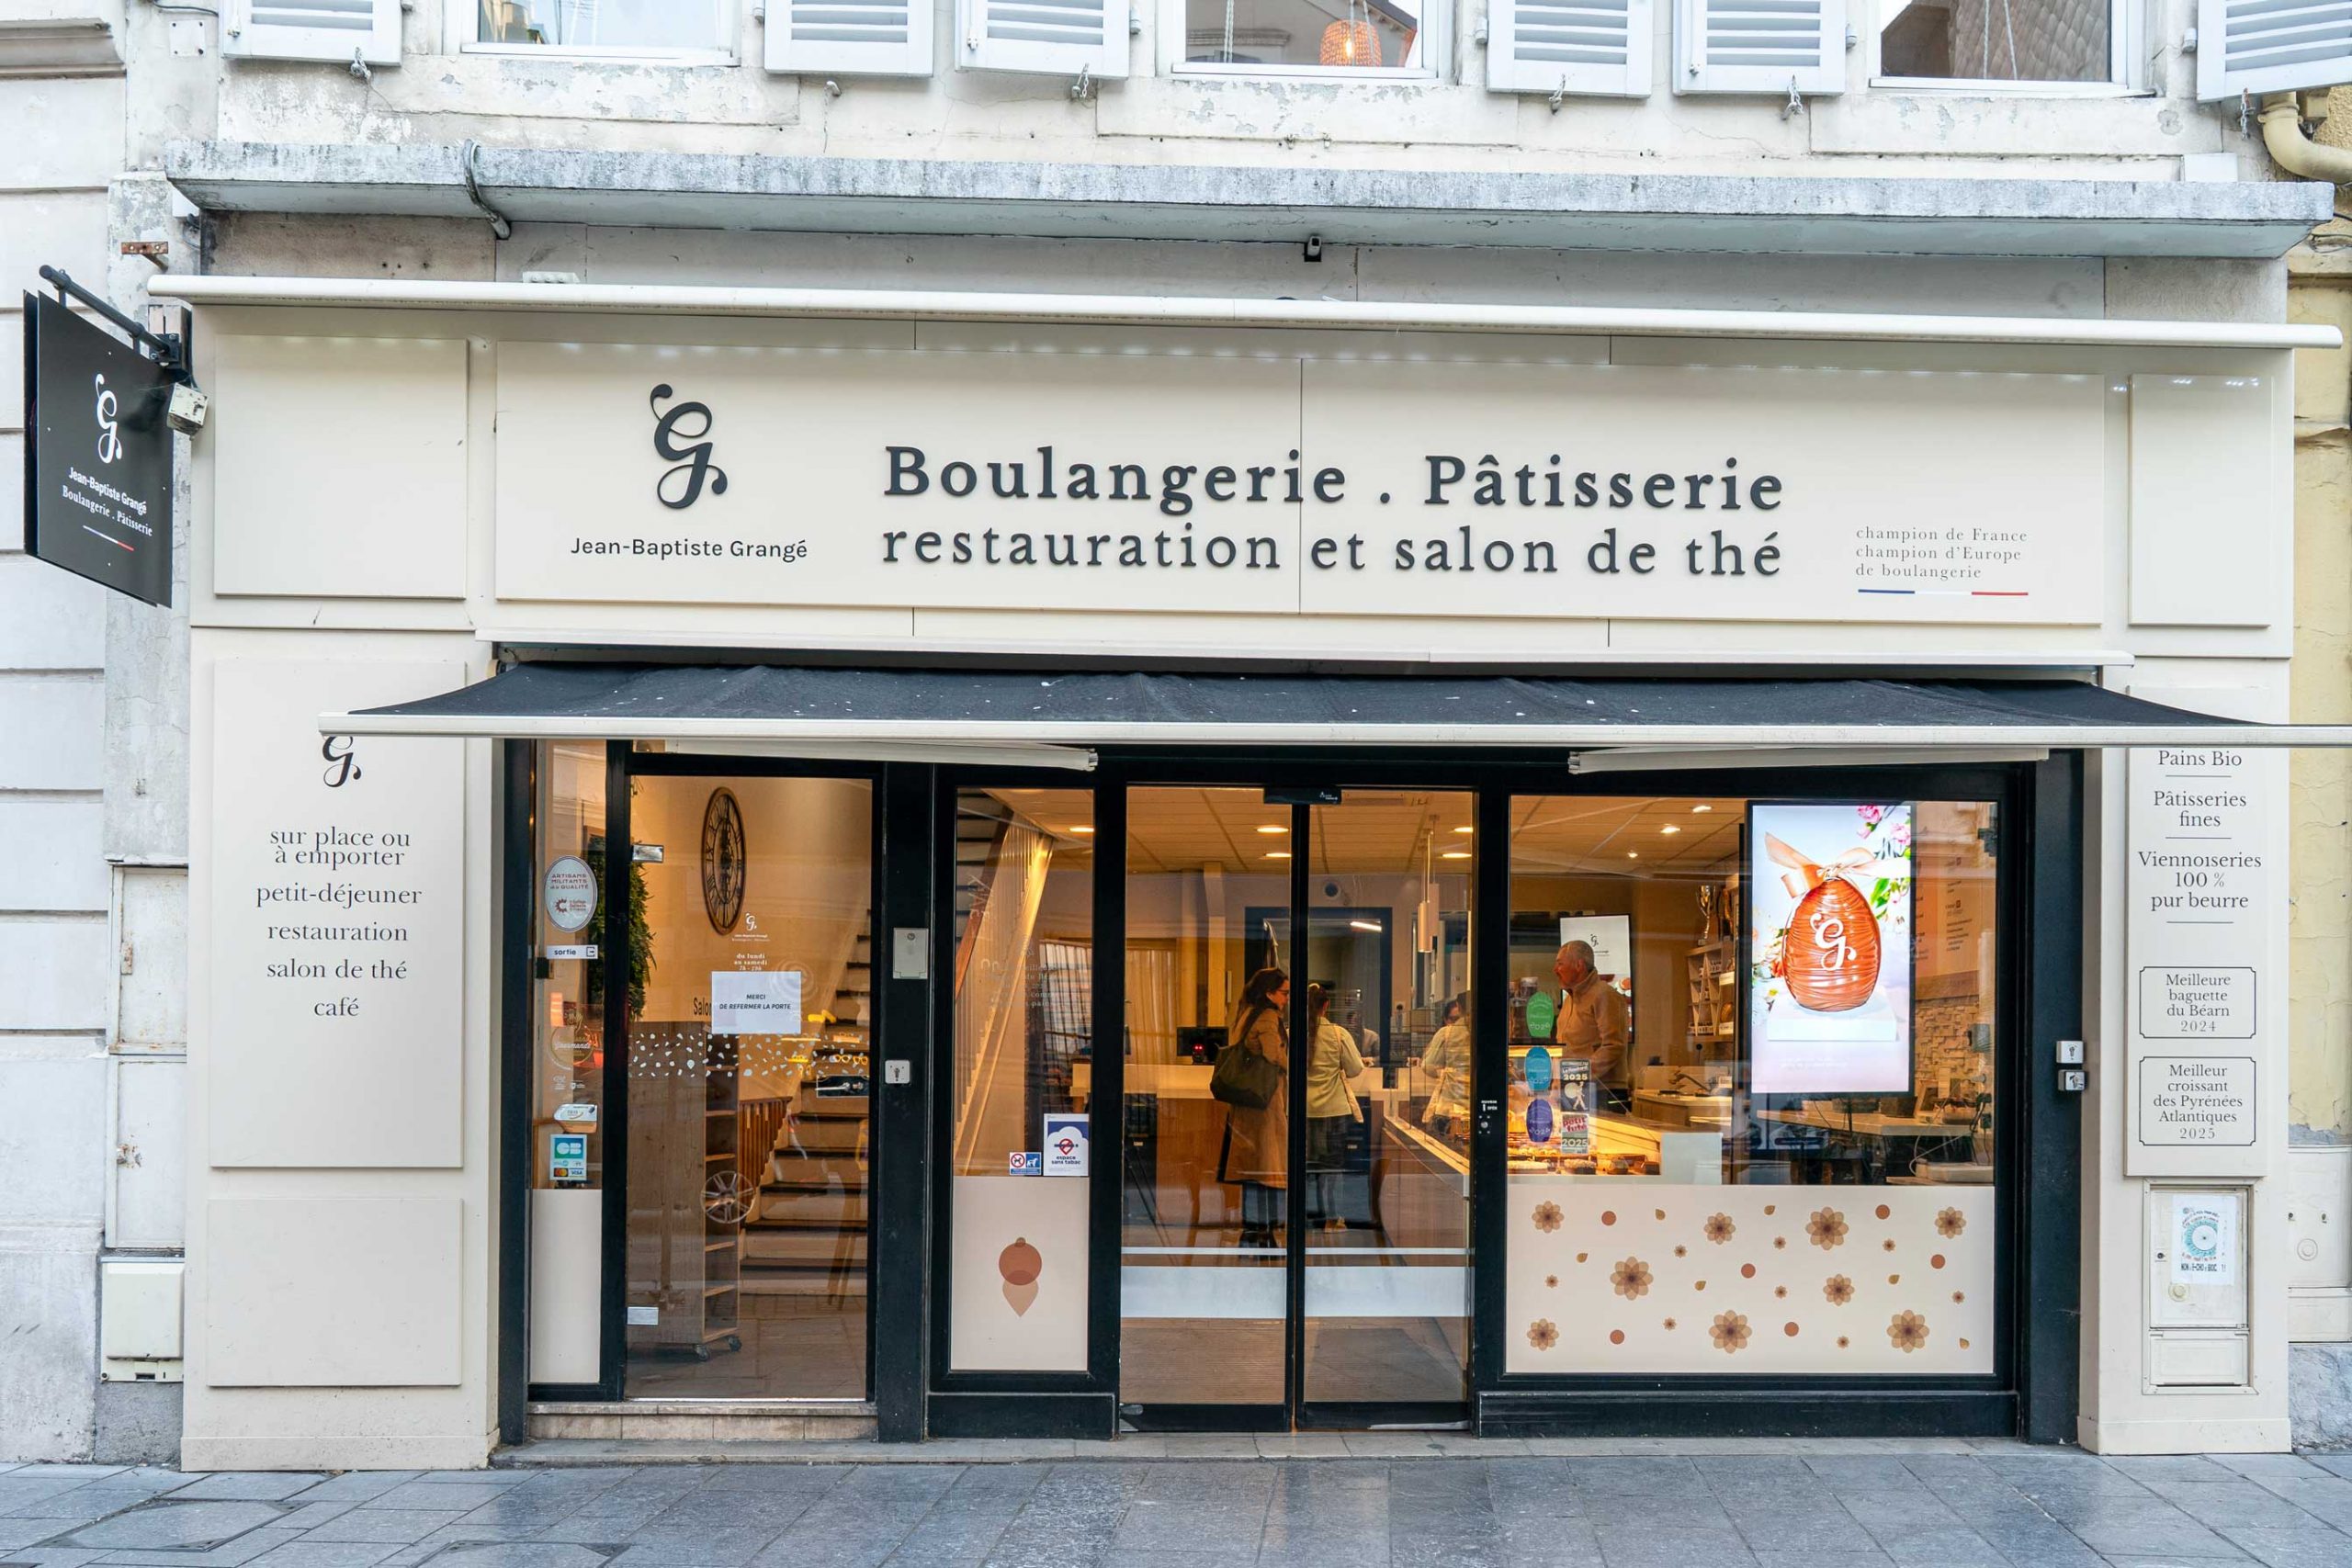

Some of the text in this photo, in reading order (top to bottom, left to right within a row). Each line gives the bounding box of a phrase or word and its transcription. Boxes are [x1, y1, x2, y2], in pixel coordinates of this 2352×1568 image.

[884, 445, 1346, 517] Boulangerie
[1424, 455, 1782, 511] Pâtisserie
[68, 466, 147, 515] Jean-Baptiste Grangé
[62, 484, 110, 518] Boulangerie
[116, 510, 153, 537] Pâtisserie
[1856, 525, 2028, 544] champion de France
[571, 537, 808, 564] Jean-Baptiste Grangé
[882, 523, 1781, 578] restauration et salon de thé
[1856, 544, 1938, 562] champion
[1855, 562, 1982, 581] de boulangerie
[2158, 750, 2243, 767] Pains Bio
[2154, 790, 2247, 807] Pâtisseries
[2179, 810, 2222, 827] fines
[270, 826, 410, 852] sur place ou
[275, 846, 404, 871] à emporter
[2138, 851, 2262, 868] Viennoiseries
[2176, 872, 2224, 887] 100 %
[256, 882, 423, 909] petit-déjeuner
[2151, 891, 2249, 911] pur beurre
[267, 921, 408, 942] restauration
[553, 948, 577, 956] sortie
[266, 957, 407, 979] salon de thé
[2165, 973, 2231, 987] Meilleure
[2168, 988, 2228, 1004] baguette
[313, 997, 359, 1017] café
[2166, 1004, 2230, 1017] du Béarn
[2180, 1020, 2217, 1032] 2024
[2169, 1064, 2228, 1077] Meilleur
[2167, 1079, 2228, 1092] croissant
[2153, 1094, 2243, 1111] des Pyrénées
[2158, 1110, 2237, 1126] Atlantiques
[2179, 1127, 2216, 1140] 2025
[1562, 1138, 1589, 1147] 2025
